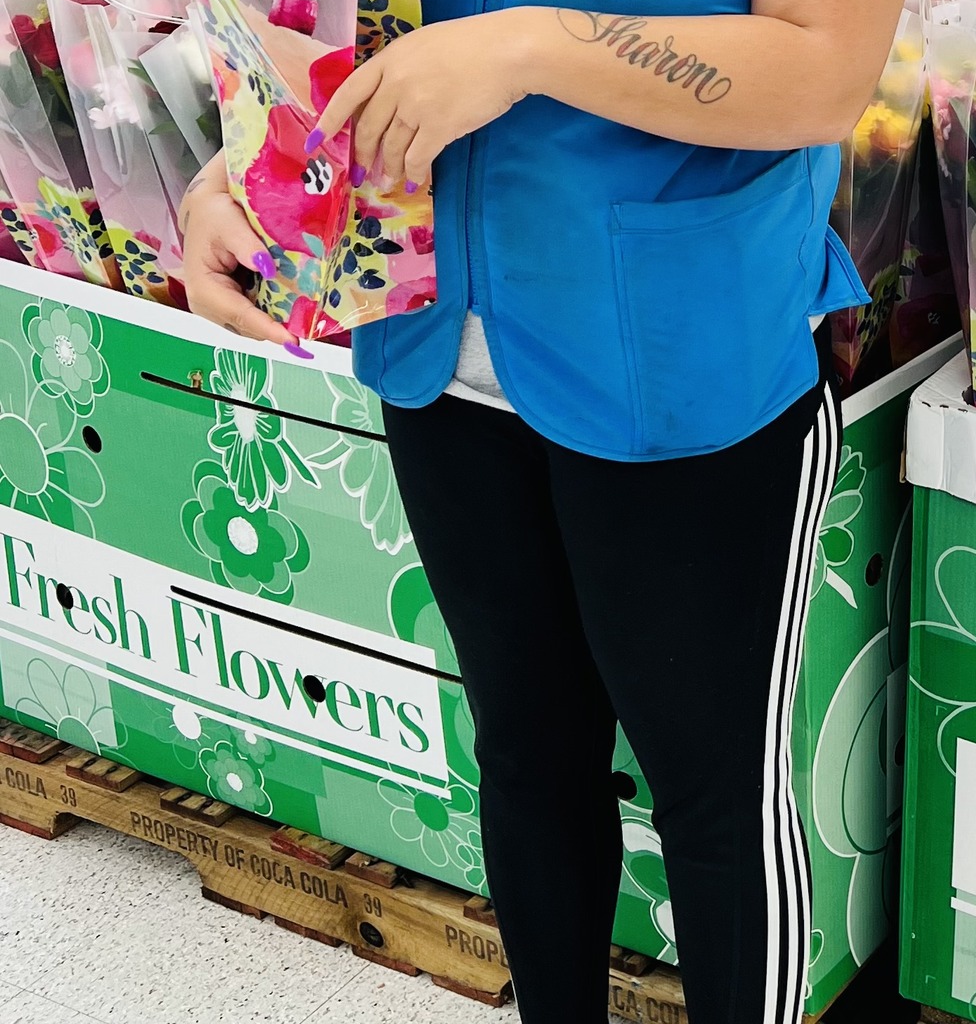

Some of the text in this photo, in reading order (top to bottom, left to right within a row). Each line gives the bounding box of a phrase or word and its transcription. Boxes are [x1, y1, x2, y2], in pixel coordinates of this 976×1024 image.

[557, 8, 732, 104] Sharon
[0, 532, 430, 754] Fresh Flowers
[5, 767, 78, 808] COLA 39
[130, 811, 383, 918] PROPERTY OF COCA COLA 39
